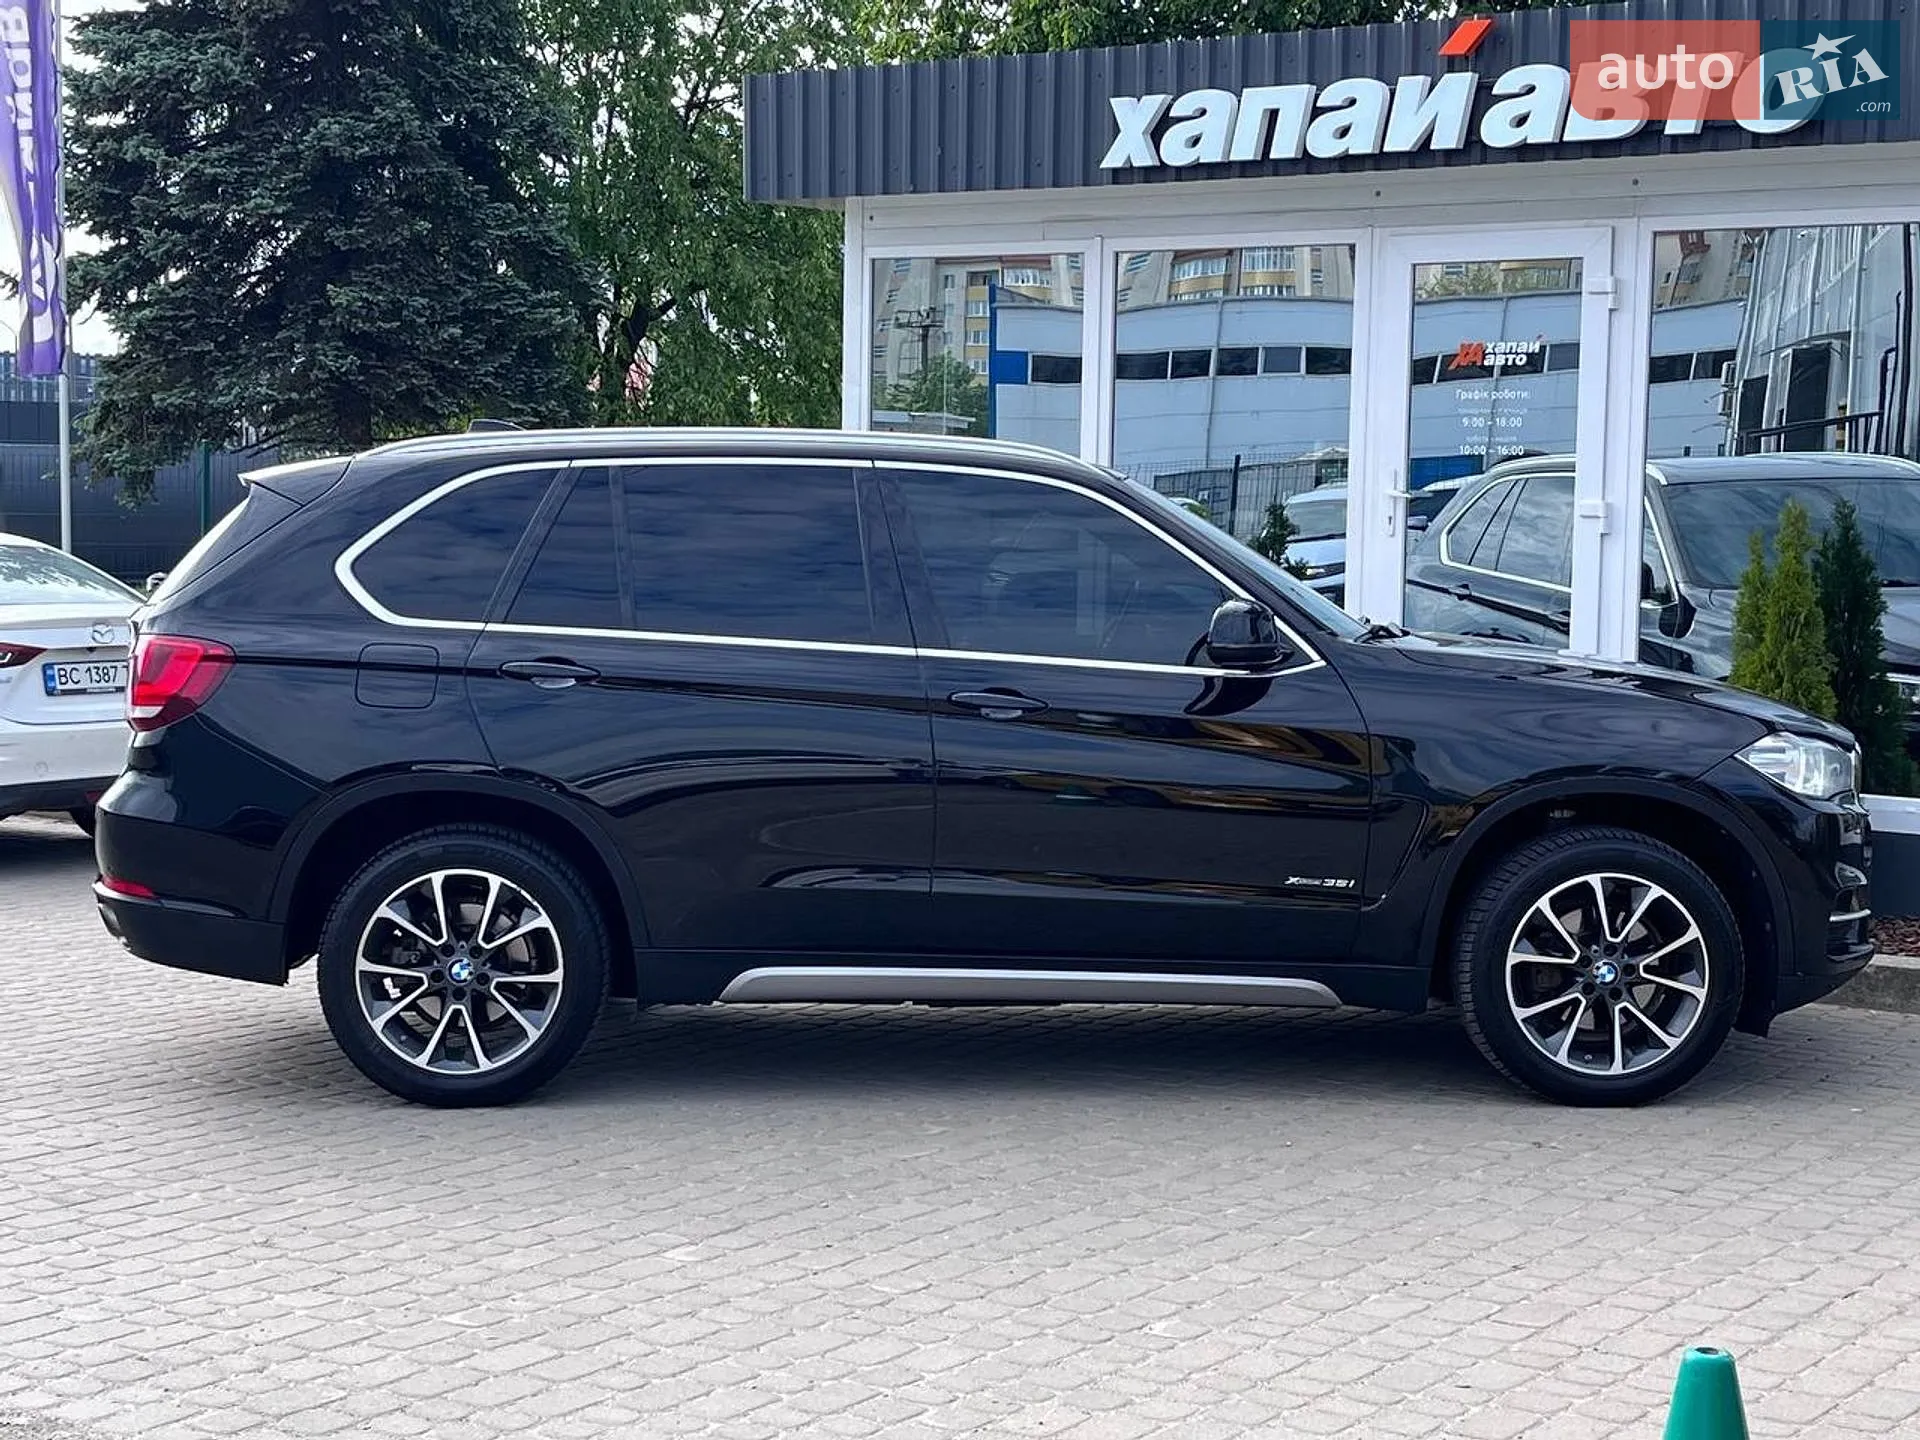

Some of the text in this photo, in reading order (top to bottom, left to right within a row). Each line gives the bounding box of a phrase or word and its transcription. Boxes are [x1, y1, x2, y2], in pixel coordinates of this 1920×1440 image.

[1100, 17, 1827, 169] хапай авто
[1483, 353, 1527, 366] авто
[1460, 444, 1487, 456] 10:00
[1498, 444, 1525, 456] 16:00
[85, 664, 118, 684] 1387
